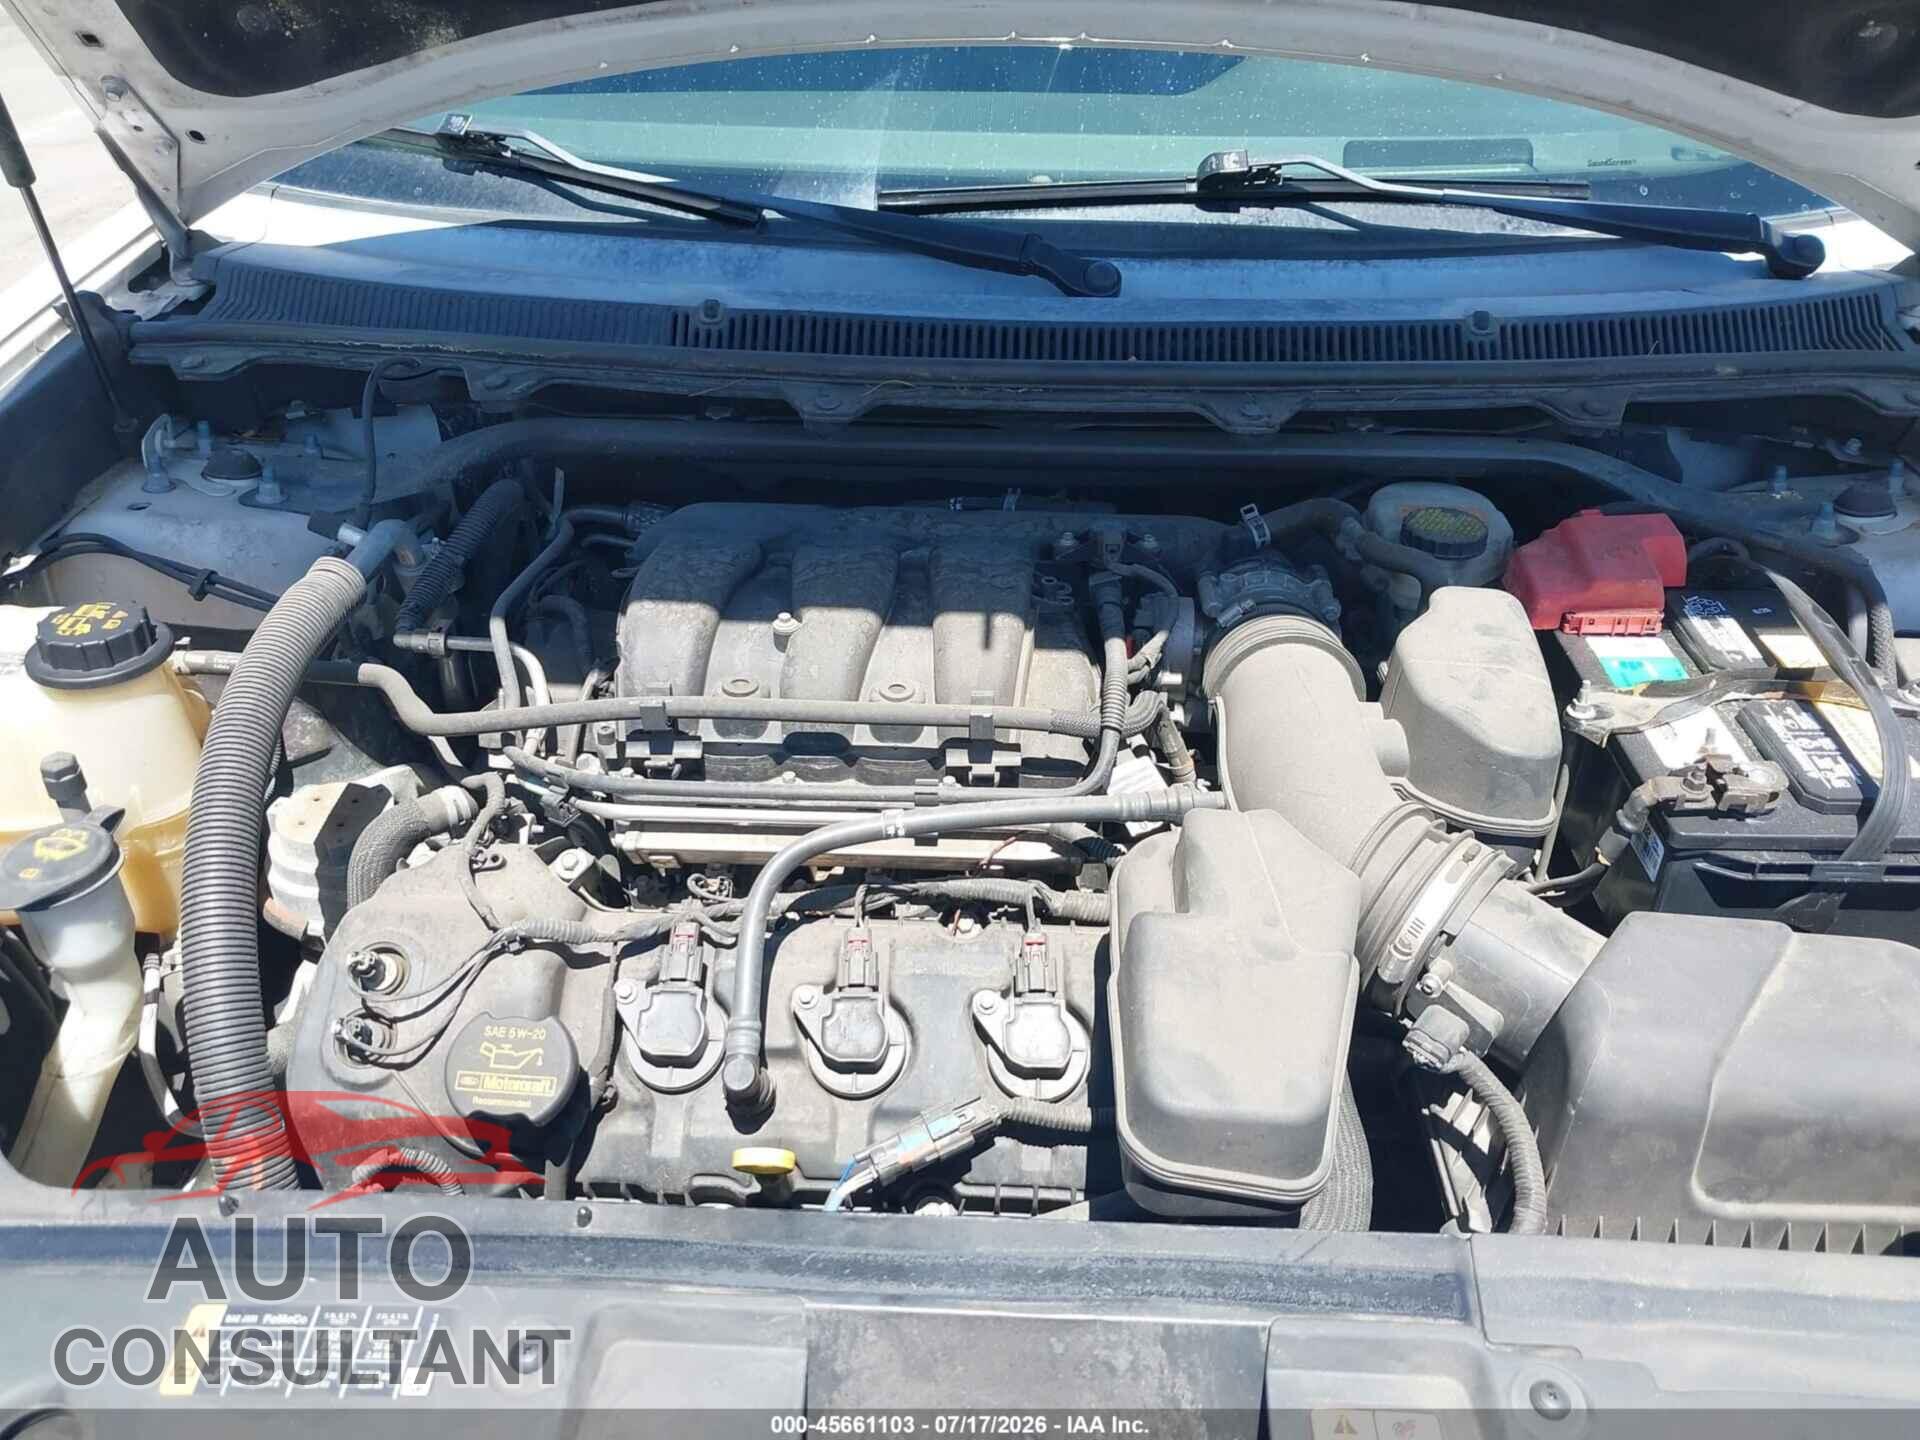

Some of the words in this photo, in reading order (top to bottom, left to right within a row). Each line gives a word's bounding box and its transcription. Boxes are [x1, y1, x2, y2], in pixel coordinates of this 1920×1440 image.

[484, 1025, 508, 1038] SAE
[509, 1026, 546, 1040] 5W-20
[483, 1075, 551, 1093] Motorcraft
